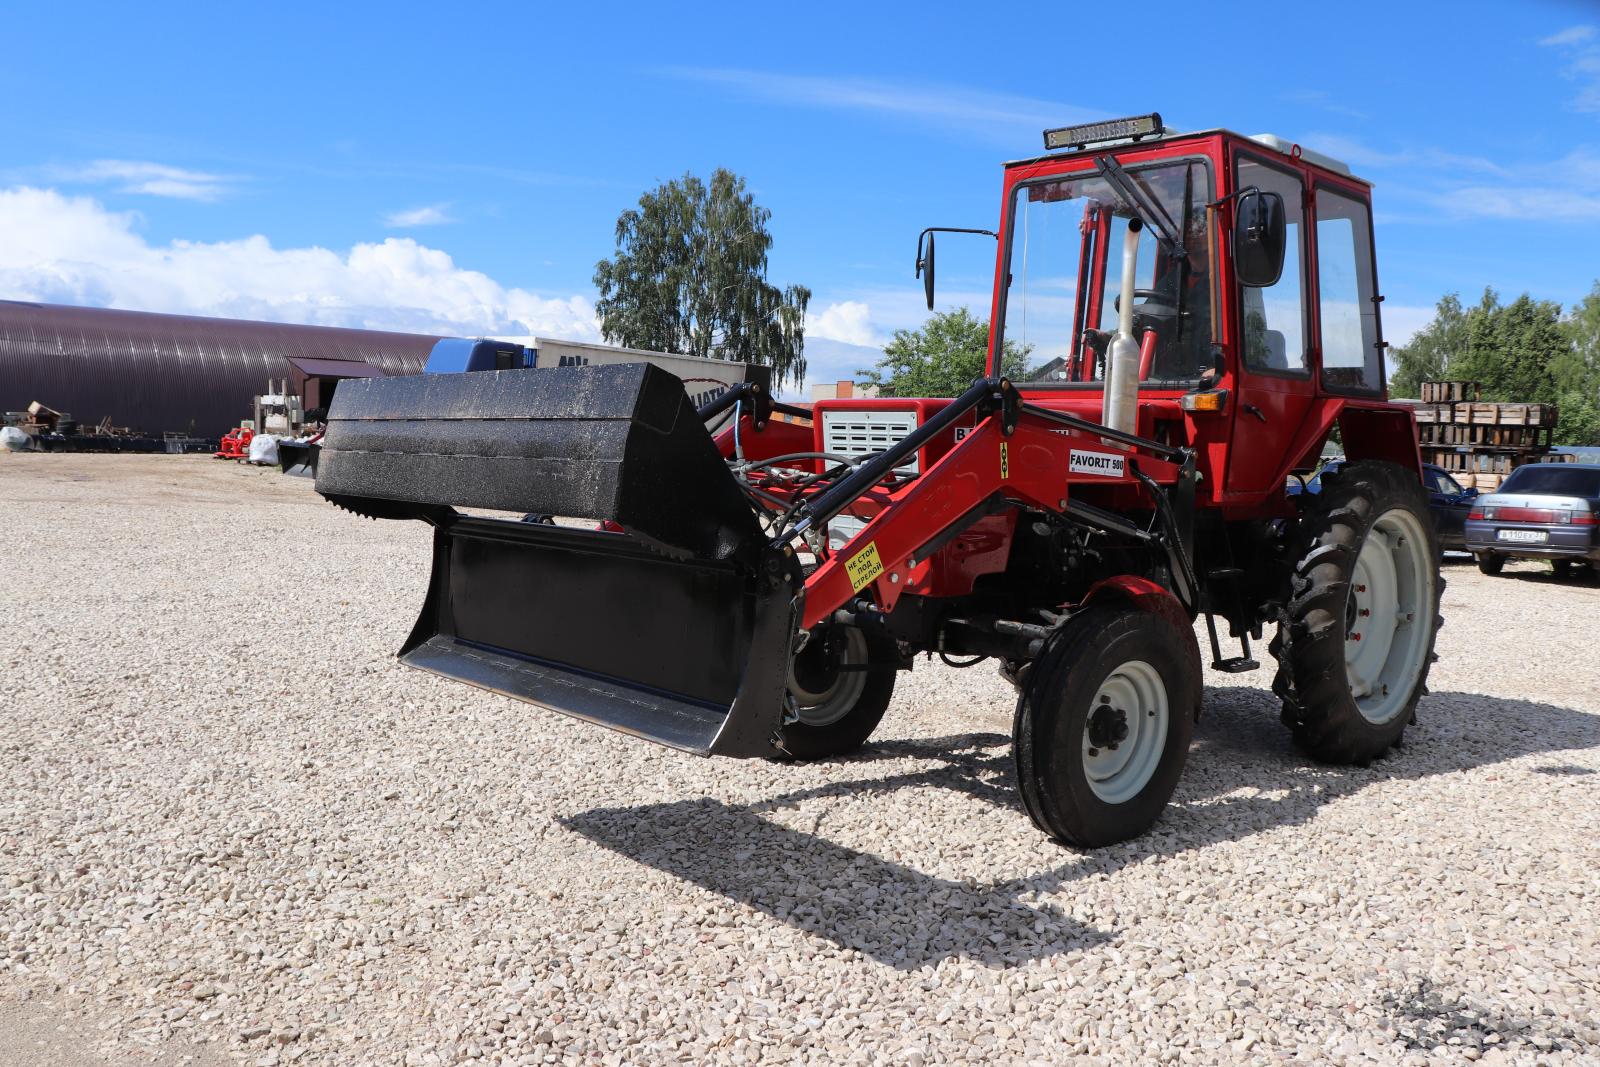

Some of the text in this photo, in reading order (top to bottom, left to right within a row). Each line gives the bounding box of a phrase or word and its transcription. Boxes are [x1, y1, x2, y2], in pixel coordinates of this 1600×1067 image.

[1070, 454, 1110, 469] FAVORIT
[848, 545, 875, 571] НЕ СТОЙ
[857, 560, 872, 574] ПОД
[853, 562, 882, 589] СТРЕЛОЙ
